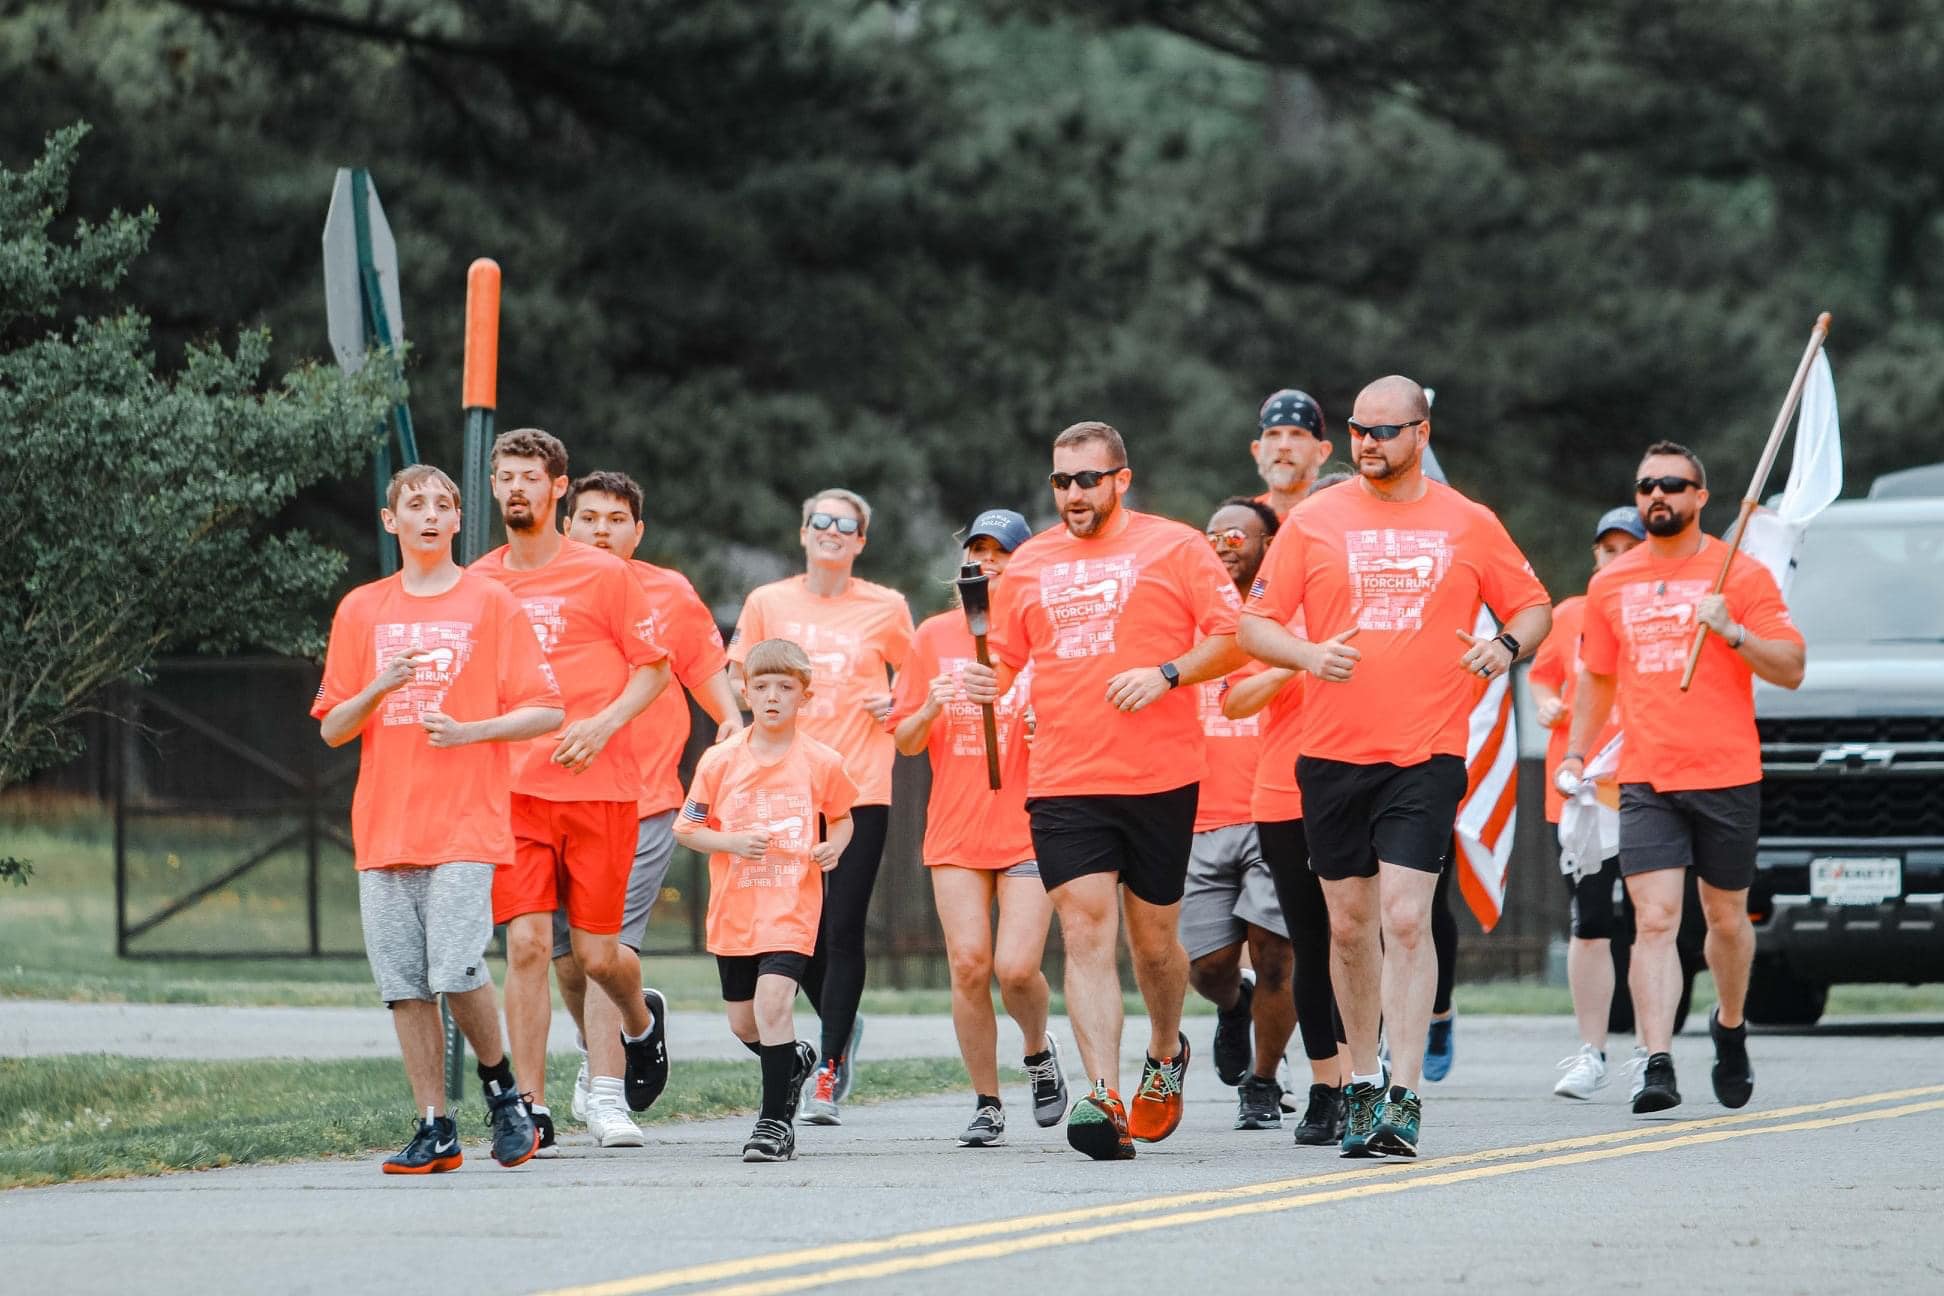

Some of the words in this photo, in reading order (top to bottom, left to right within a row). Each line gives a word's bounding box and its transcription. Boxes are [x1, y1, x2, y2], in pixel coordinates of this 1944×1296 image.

[1363, 578, 1404, 588] TORCH
[1406, 578, 1431, 588] RUN
[1055, 604, 1094, 618] TORCH
[1095, 600, 1117, 613] RUN
[425, 671, 449, 681] RUN
[995, 704, 1013, 715] UN
[779, 839, 802, 849] RUN
